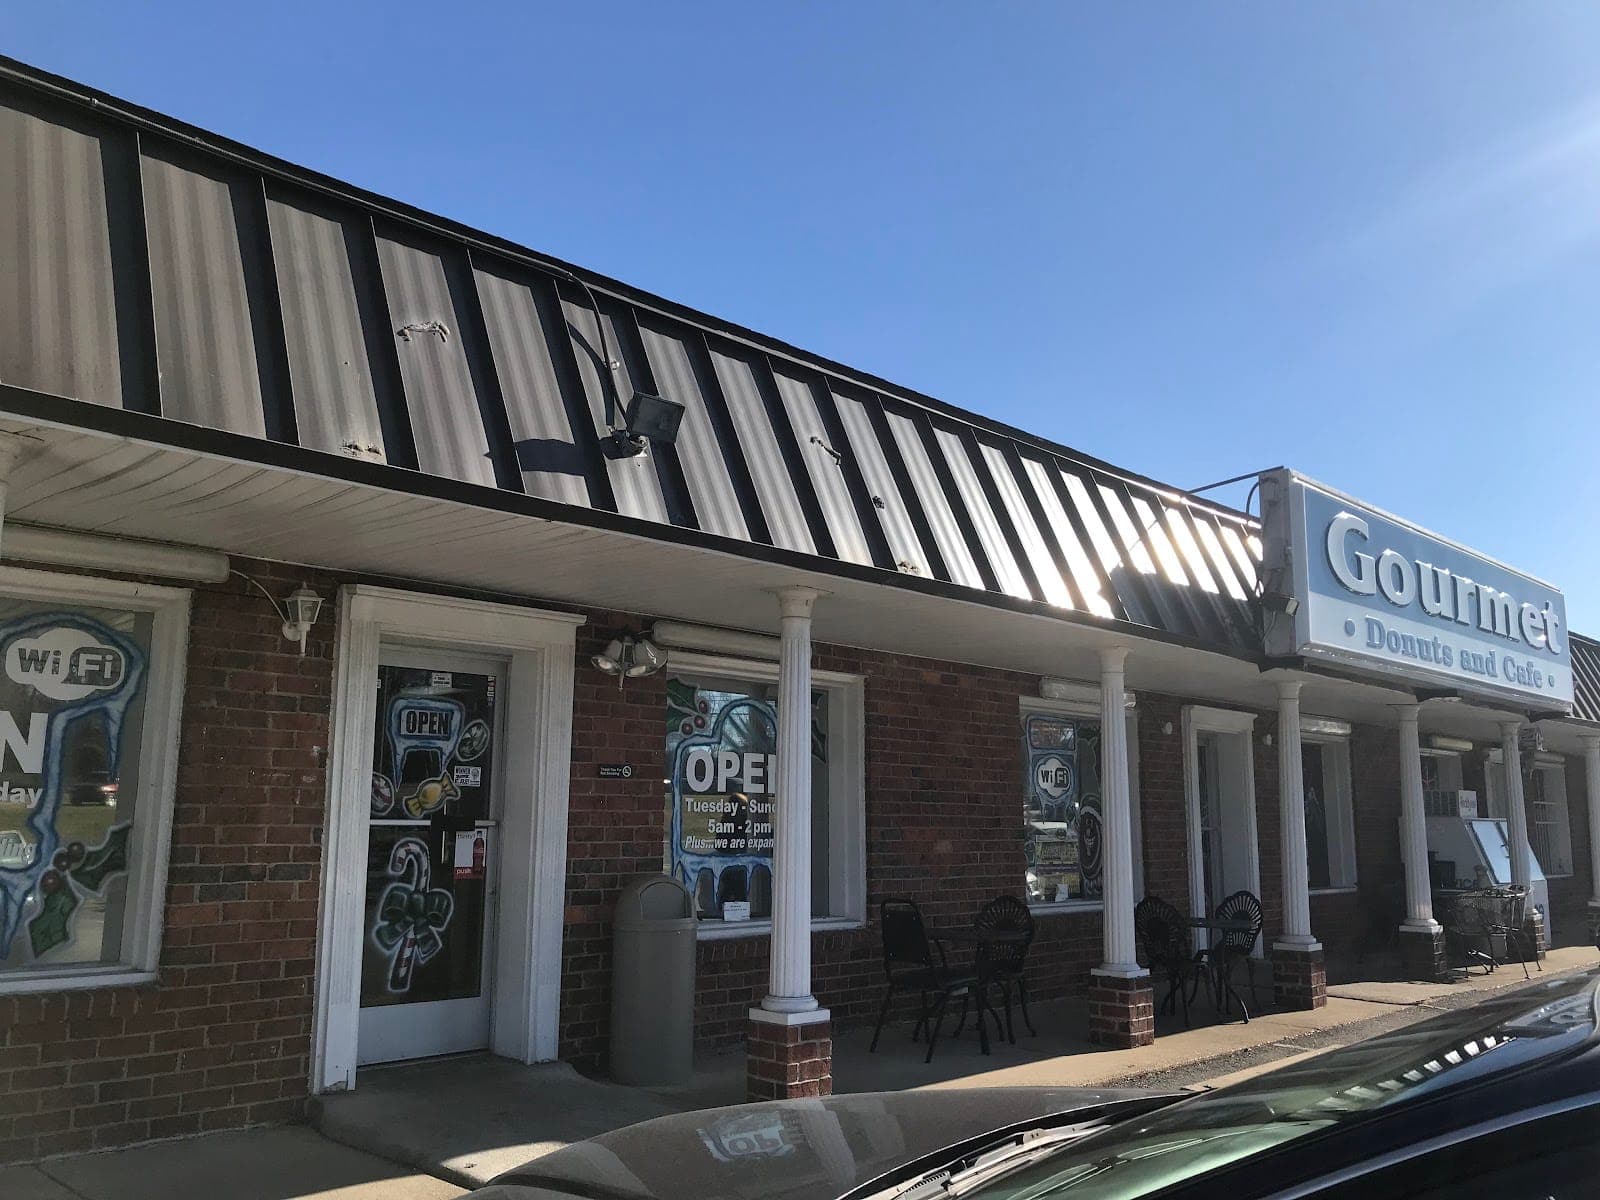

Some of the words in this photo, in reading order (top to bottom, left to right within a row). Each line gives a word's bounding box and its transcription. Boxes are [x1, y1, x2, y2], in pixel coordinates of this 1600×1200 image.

[1326, 511, 1561, 655] Gourmet
[1366, 614, 1453, 667] Donuts
[1460, 649, 1498, 679] and
[1503, 656, 1542, 688] Cafe
[405, 711, 449, 734] OPEN
[685, 797, 739, 816] Tuesday
[708, 818, 735, 833] 5am
[730, 839, 745, 849] are
